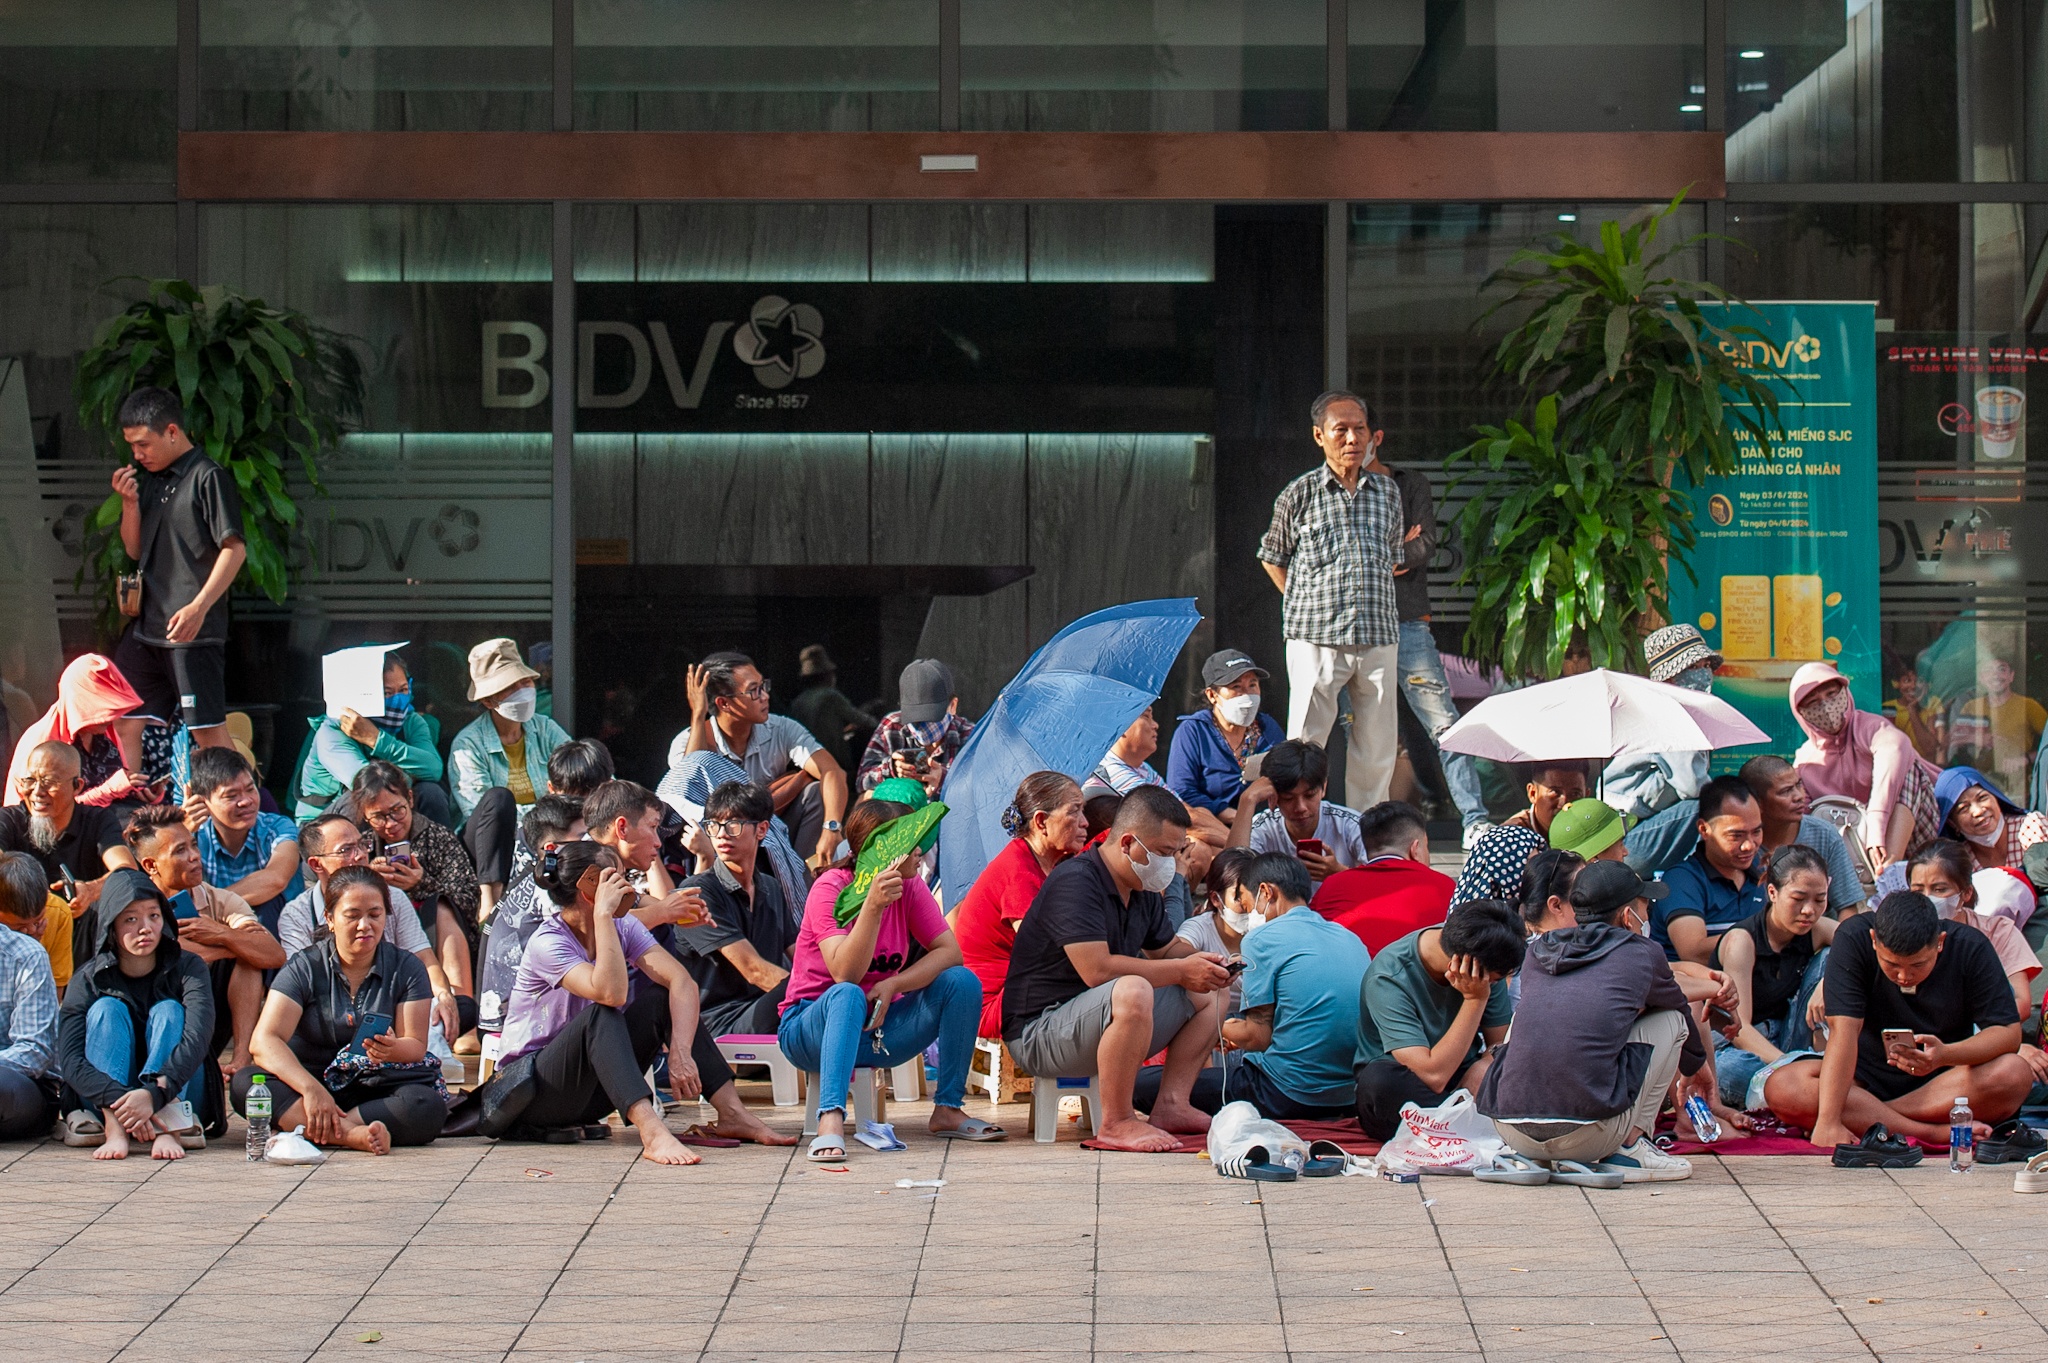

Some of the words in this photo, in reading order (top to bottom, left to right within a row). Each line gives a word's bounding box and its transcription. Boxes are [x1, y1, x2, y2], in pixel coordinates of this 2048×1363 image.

[1888, 347, 1979, 362] SKYLINE
[482, 321, 734, 408] BDV
[777, 394, 809, 408] 1957
[1788, 427, 1825, 441] MIẾNG
[1828, 430, 1852, 441] SJC
[1778, 447, 1803, 458] CHO
[1748, 462, 1783, 475] HÀNG
[1786, 462, 1803, 475] CÁ
[1805, 462, 1841, 475] NHÂN
[1740, 491, 1760, 501] Ngày
[1762, 491, 1808, 500] 03/6/2024
[1401, 1109, 1450, 1132] WinMart
